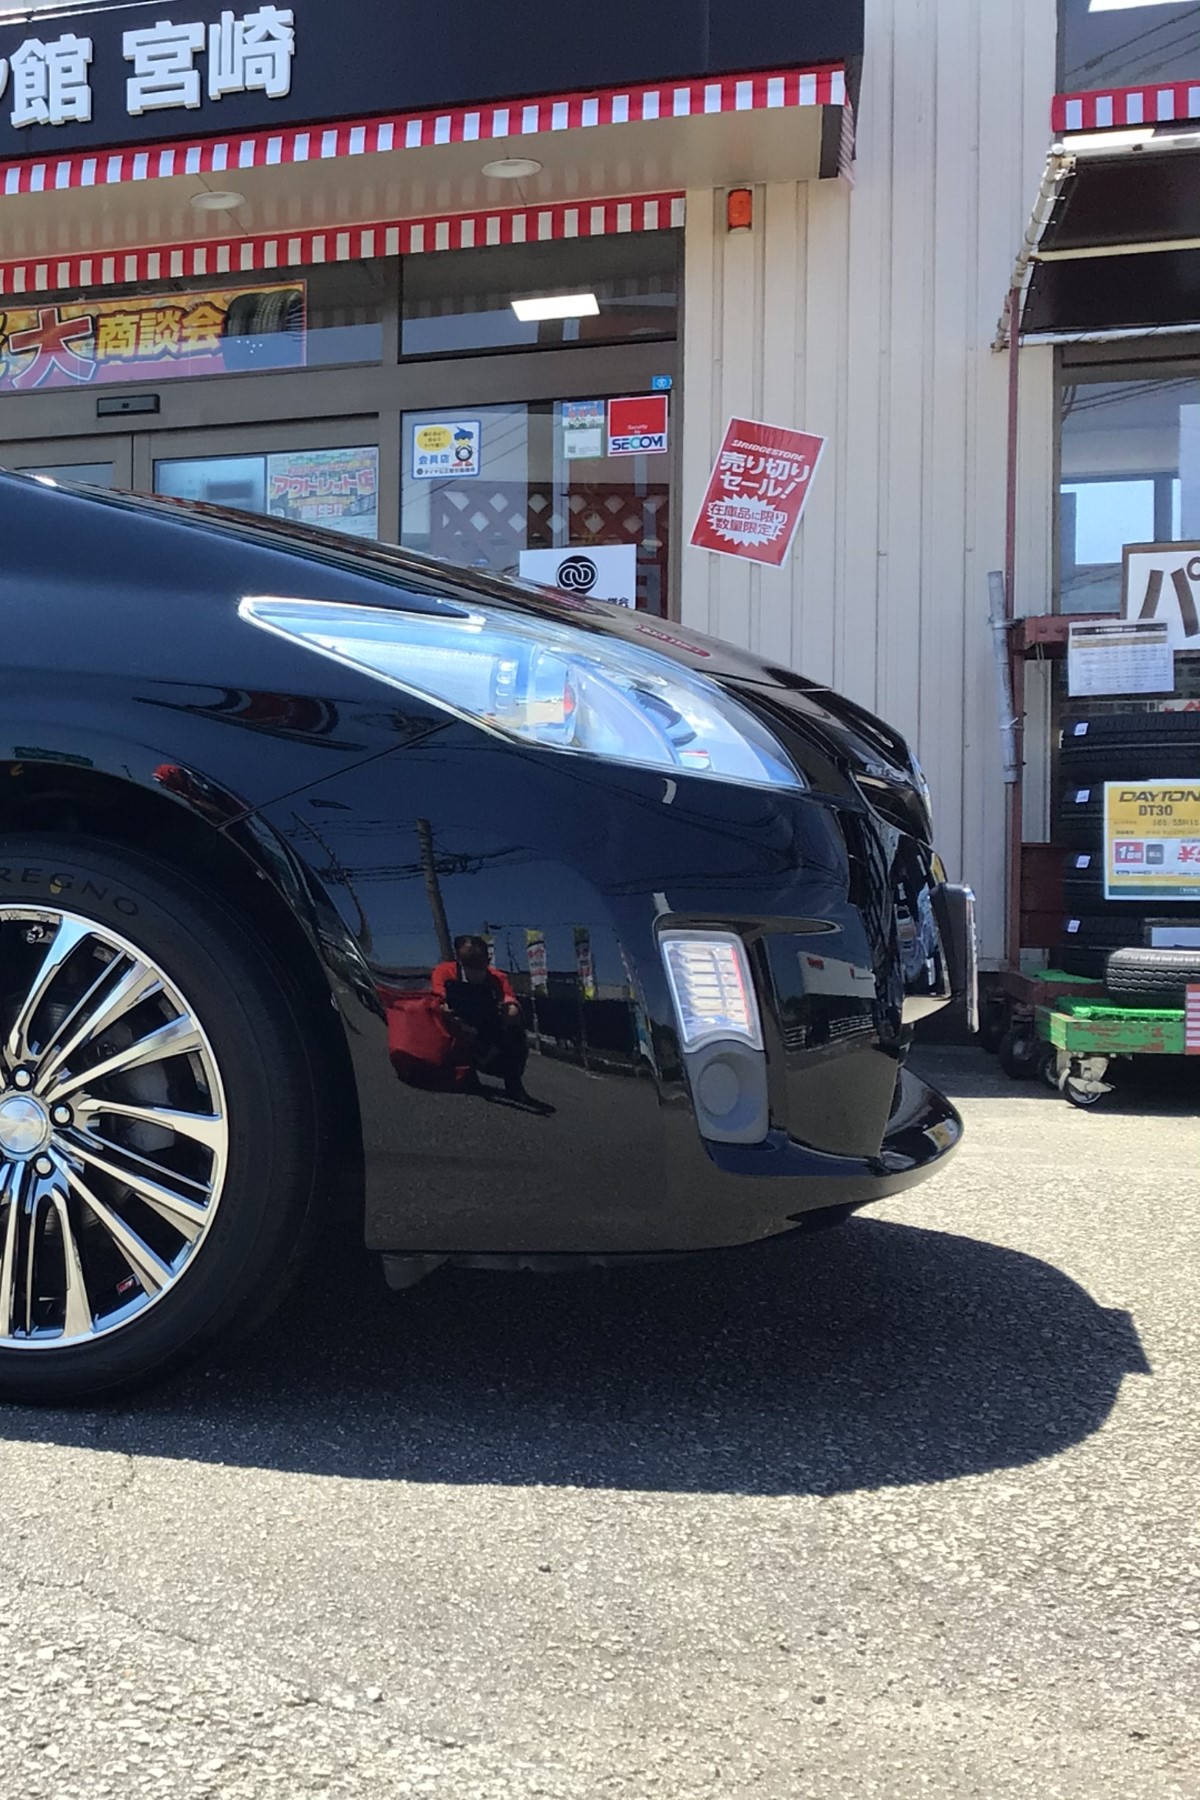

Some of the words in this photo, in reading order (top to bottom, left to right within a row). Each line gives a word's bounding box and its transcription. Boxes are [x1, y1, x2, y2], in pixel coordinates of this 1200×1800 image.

[122, 4, 295, 115] 宮崎
[611, 435, 663, 451] SECOM
[730, 439, 806, 462] BRIDGESTONE
[719, 451, 810, 483] 売り切り
[710, 503, 788, 525] 在庫品に限り
[1138, 804, 1173, 817] DT30
